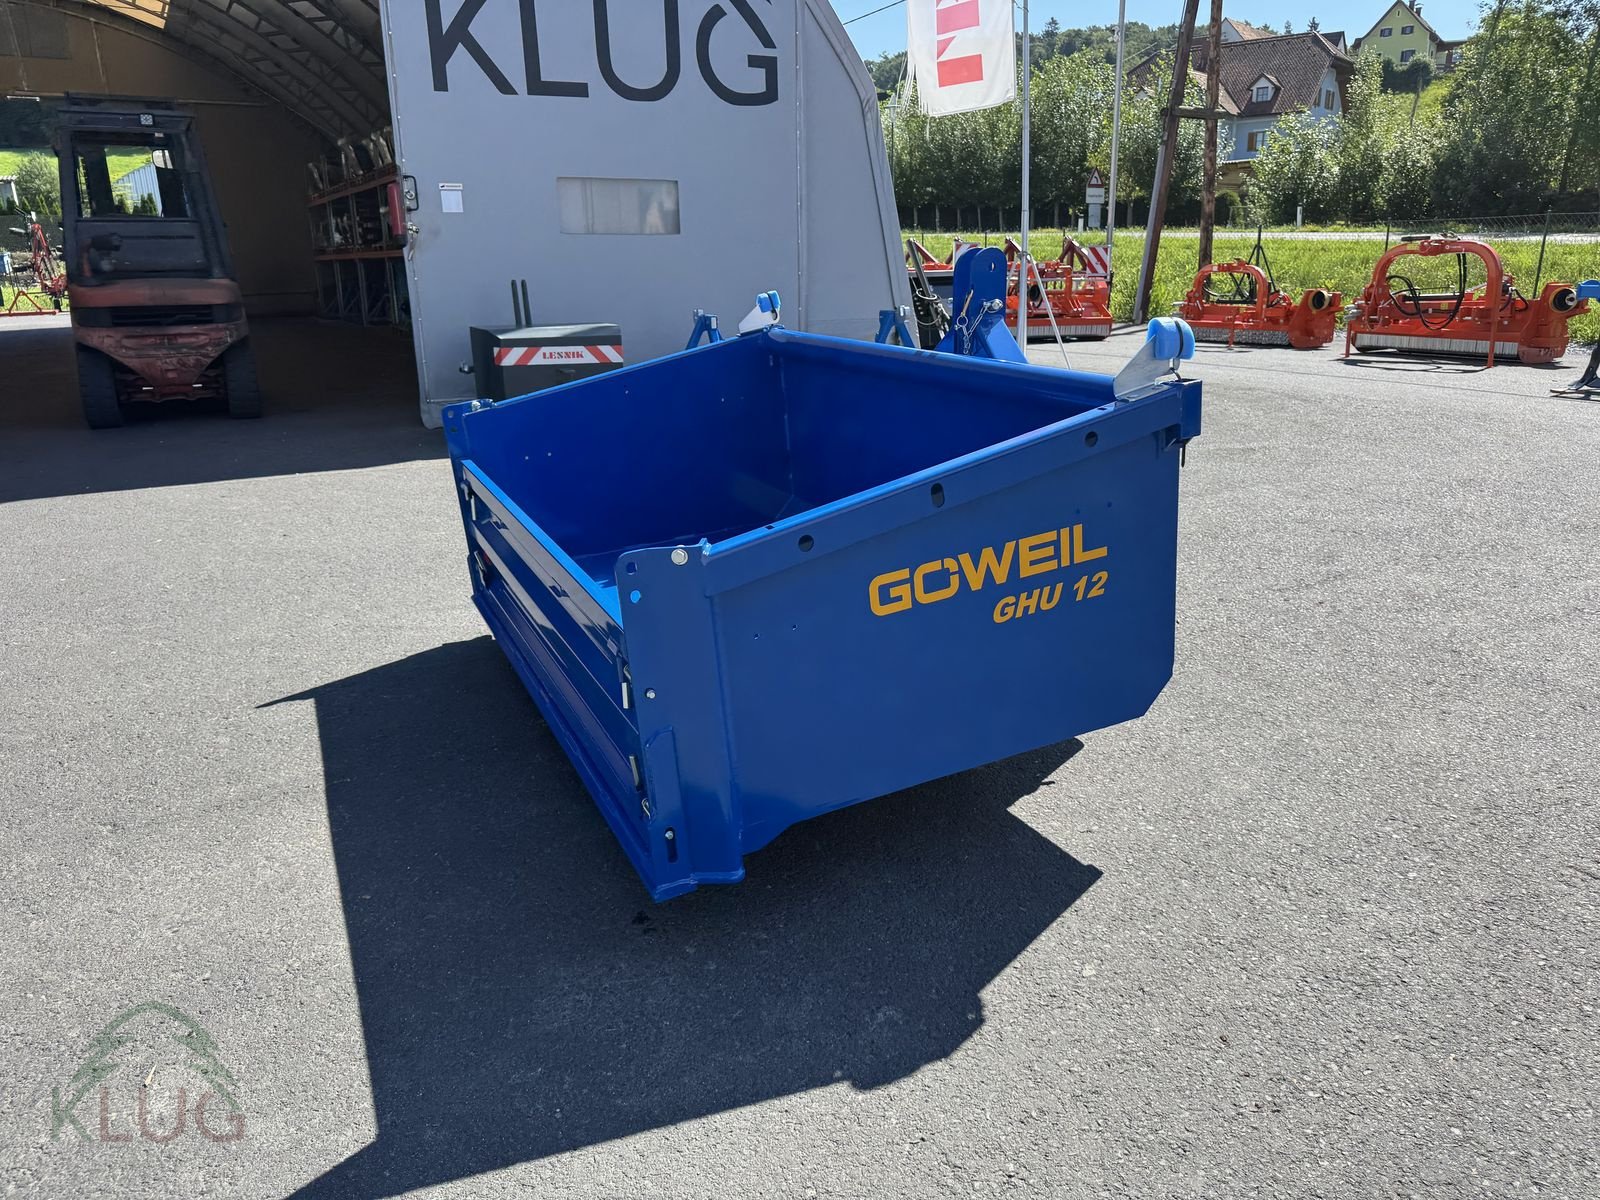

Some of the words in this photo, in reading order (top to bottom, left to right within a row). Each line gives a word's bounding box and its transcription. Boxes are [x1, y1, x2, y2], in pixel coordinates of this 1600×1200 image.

[425, 0, 779, 106] KLUG
[542, 351, 585, 360] LESNIK
[993, 582, 1063, 624] GHU
[1073, 571, 1109, 601] 12
